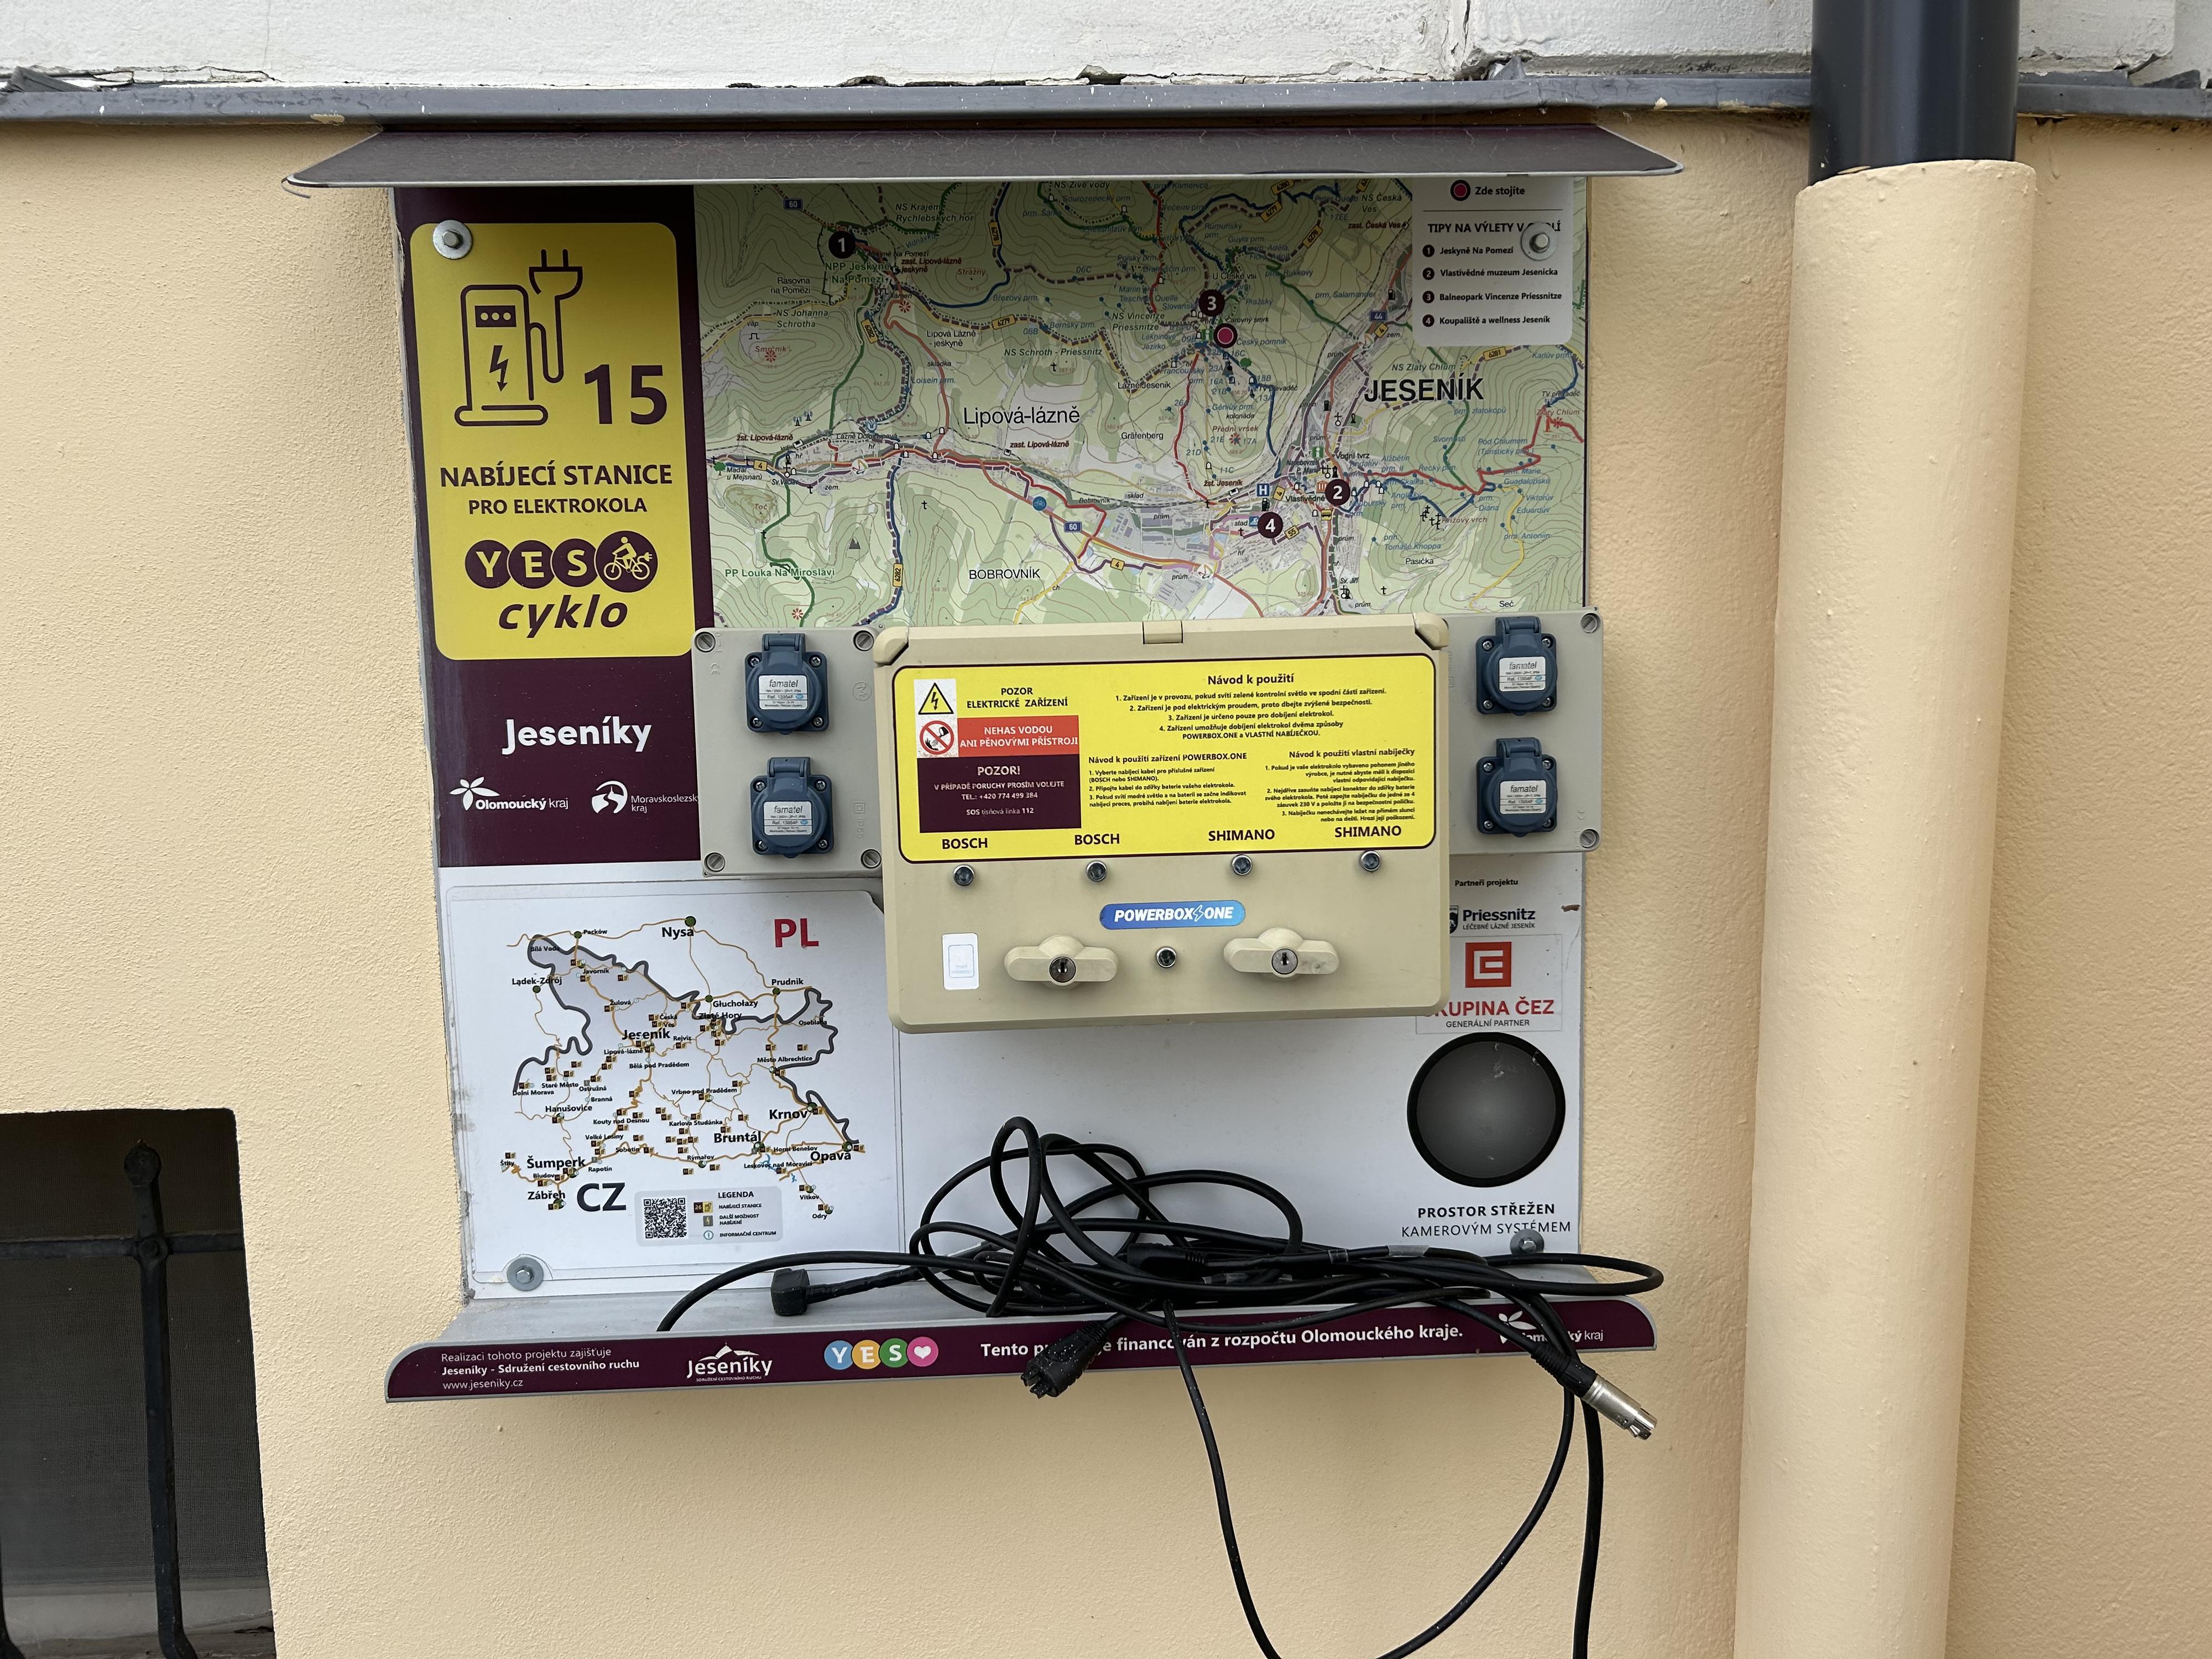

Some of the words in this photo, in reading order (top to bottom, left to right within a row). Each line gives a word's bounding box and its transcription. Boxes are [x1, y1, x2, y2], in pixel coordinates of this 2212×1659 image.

[1475, 186, 1493, 195] Zde
[1495, 187, 1525, 197] stojíte
[1428, 223, 1451, 233] TIPY
[1455, 223, 1472, 232] NA
[1474, 221, 1514, 232] VÝLETY
[1517, 223, 1524, 232] V
[1439, 293, 1483, 302] Balneopark
[997, 318, 1010, 327] 6279
[1439, 317, 1480, 326] Koupaliště
[1406, 363, 1427, 372] Zlatý
[1430, 363, 1455, 371] Chlum
[1364, 372, 1484, 402] JESENÍK
[584, 364, 667, 425] 15
[964, 405, 1080, 427] Lipová-lázně
[1121, 432, 1164, 440] Gräfenberg
[1027, 440, 1069, 449] Lipová-lázně
[440, 461, 556, 487] NABÍJECÍ
[564, 465, 672, 485] STANICE
[468, 499, 507, 514] PRO
[514, 498, 647, 514] ELEKTROKOLA
[969, 568, 1041, 580] BOBROVNÍK
[499, 594, 628, 638] cyklo
[1509, 661, 1537, 670] famatel
[769, 679, 798, 688] famatel
[1208, 675, 1243, 685] Návod
[1247, 674, 1253, 684] k
[1256, 673, 1294, 686] použití
[1318, 689, 1340, 697] spodní
[967, 698, 1020, 708] ELEKTRICKÉ
[1025, 696, 1068, 707] ZAŘÍZENÍ
[502, 716, 651, 754] Jeseníky
[984, 726, 1016, 735] NEHAS
[1018, 726, 1052, 734] VODOU
[959, 739, 977, 747] ANI
[980, 737, 1029, 747] PĚNOVÝMI
[1032, 736, 1078, 745] PŘÍSTROJI
[1123, 755, 1149, 764] použití
[1183, 753, 1247, 761] POWERBOX.ONE
[978, 766, 1020, 775] POZOR!
[1510, 785, 1538, 793] famatel
[476, 797, 546, 810] Olomoucký
[549, 797, 568, 809] kraj
[632, 804, 648, 813] kraj
[774, 806, 803, 814] famatel
[1208, 830, 1275, 841] SHIMANO
[1334, 825, 1402, 838] SHIMANO
[942, 838, 988, 849] BOSCH
[1074, 834, 1120, 845] BOSCH
[1114, 906, 1194, 922] POWERBOX
[1204, 906, 1234, 920] ONE
[1463, 908, 1536, 921] Priessnitz
[662, 926, 694, 940] Nysa
[774, 918, 819, 947] PL
[512, 977, 562, 987] Lądek-Zdrój
[771, 978, 804, 986] Prudnik
[713, 1000, 758, 1008] Głuchołazy
[1515, 996, 1554, 1015] ČEZ
[1446, 1019, 1492, 1027] GENERÁLNÍ
[622, 1029, 670, 1040] Jeseník
[769, 1110, 807, 1119] Krnov
[714, 1131, 761, 1143] Bruntál
[526, 1156, 586, 1170] Šumperk
[811, 1151, 851, 1163] Opava
[527, 1190, 566, 1200] Zábřeh
[577, 1182, 627, 1212] CZ
[1418, 1206, 1486, 1218] PROSTOR
[1491, 1201, 1554, 1215] STŘEŽEN
[1402, 1221, 1491, 1237] KAMEROVÝM
[980, 1343, 1029, 1357] Tento
[1211, 1336, 1220, 1347] z
[1224, 1331, 1296, 1348] rozpočtu
[1301, 1325, 1415, 1344] Olomouckého
[1419, 1323, 1463, 1341] kraje.
[1584, 1329, 1603, 1343] kraj
[441, 1352, 484, 1362] Realizaci
[488, 1351, 522, 1360] tohoto
[525, 1349, 567, 1361] projektu
[570, 1347, 611, 1359] zajišťuje
[442, 1365, 487, 1376] Jeseníky
[498, 1363, 545, 1374] Sdružení
[548, 1361, 606, 1372] cestovního
[609, 1360, 640, 1369] ruchu
[687, 1357, 773, 1379] Jeseníky
[443, 1378, 523, 1390] www.jeseniky.cz
